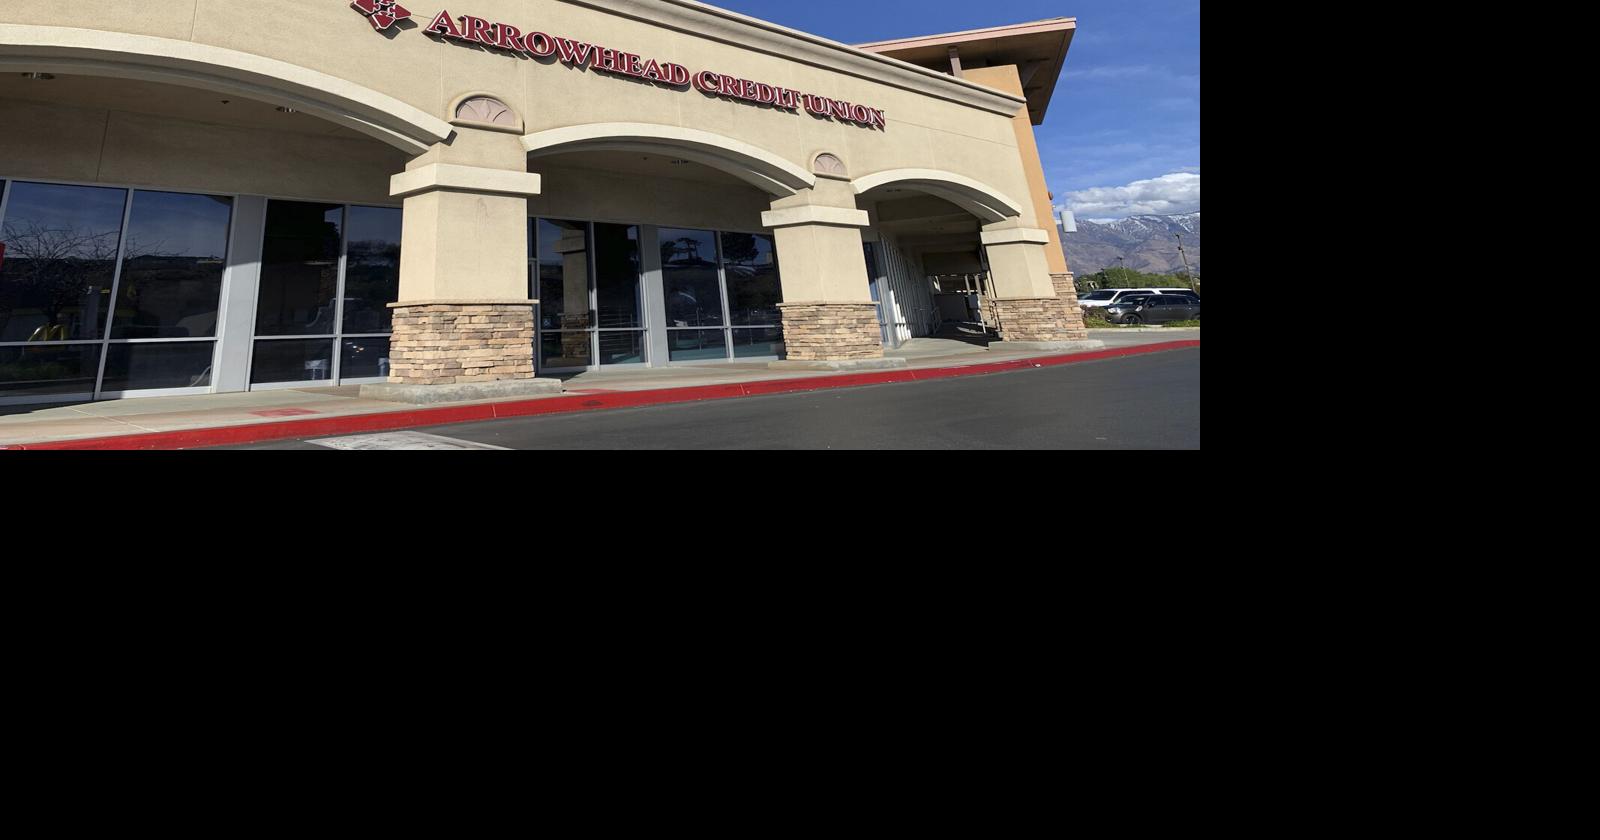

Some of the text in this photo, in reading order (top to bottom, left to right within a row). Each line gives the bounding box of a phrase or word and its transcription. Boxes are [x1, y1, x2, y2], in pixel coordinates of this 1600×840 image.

[425, 10, 885, 127] ARROWHEAD CREDIT UNION
